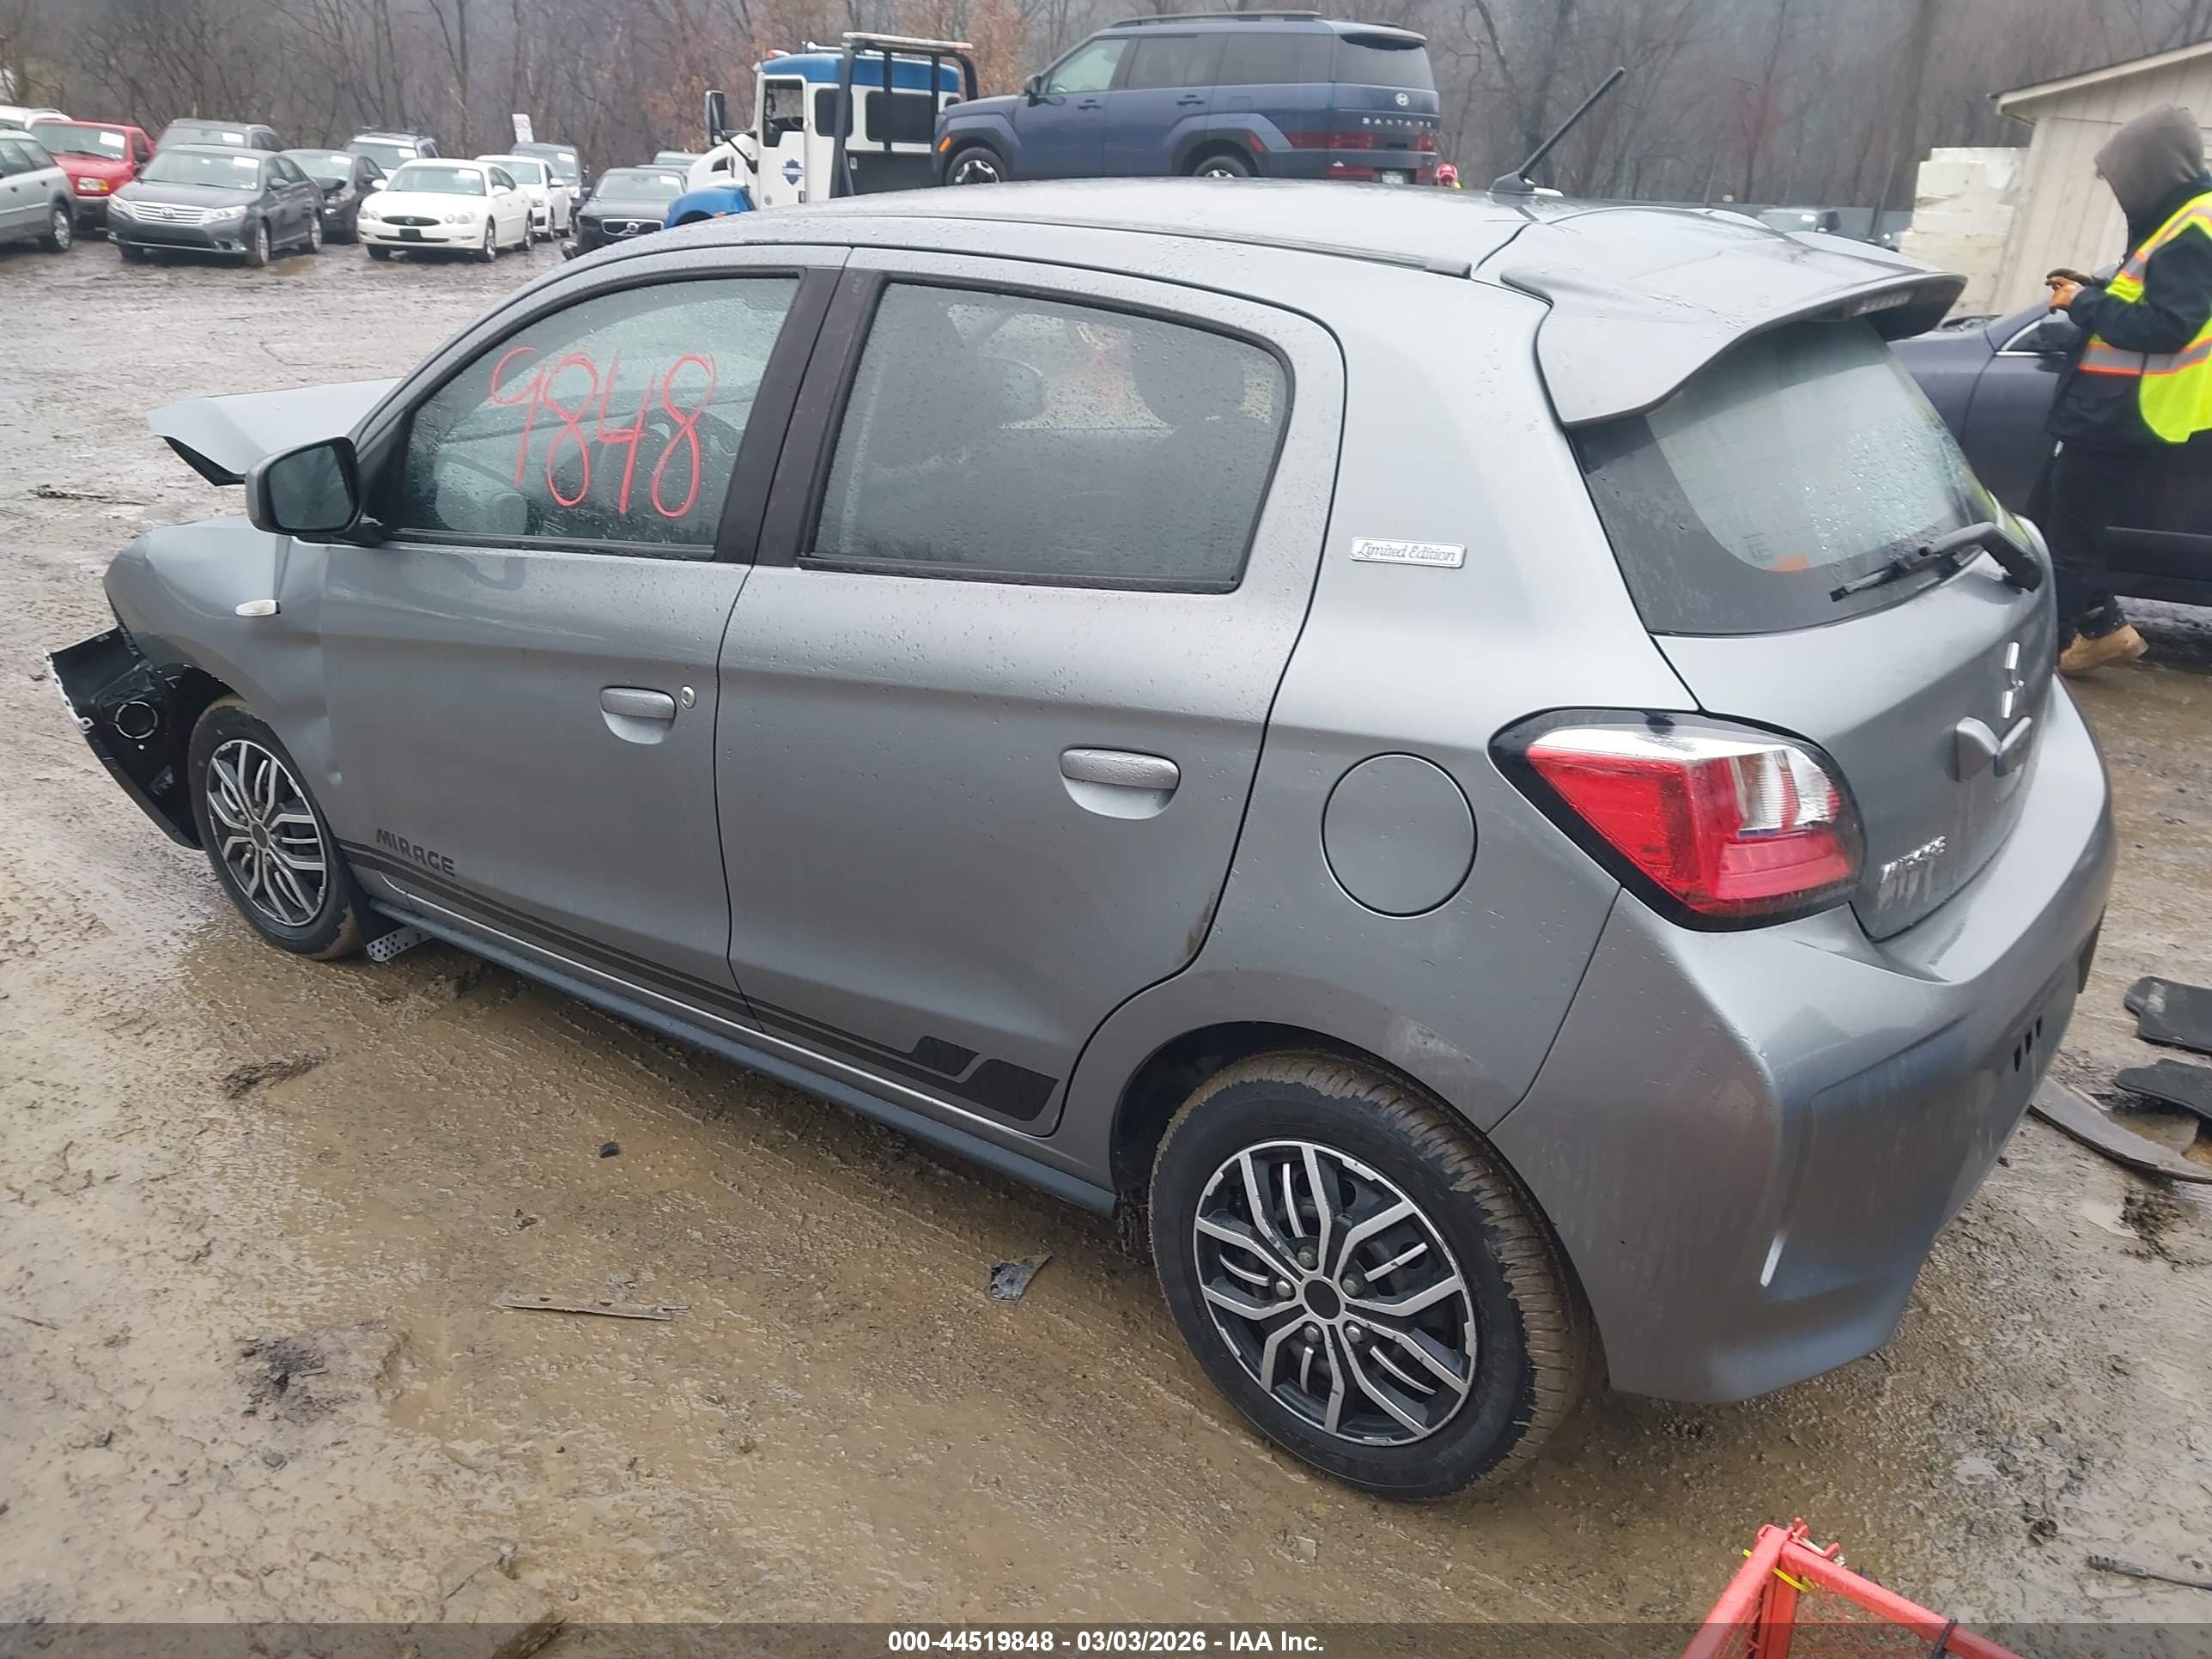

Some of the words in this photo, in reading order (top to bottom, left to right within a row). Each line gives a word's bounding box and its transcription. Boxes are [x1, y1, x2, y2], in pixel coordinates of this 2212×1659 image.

[1362, 117, 1413, 127] SANTA
[490, 346, 717, 518] 9848
[1358, 542, 1408, 558] Limited
[1408, 545, 1455, 562] Edition
[376, 828, 456, 877] MIRAGE
